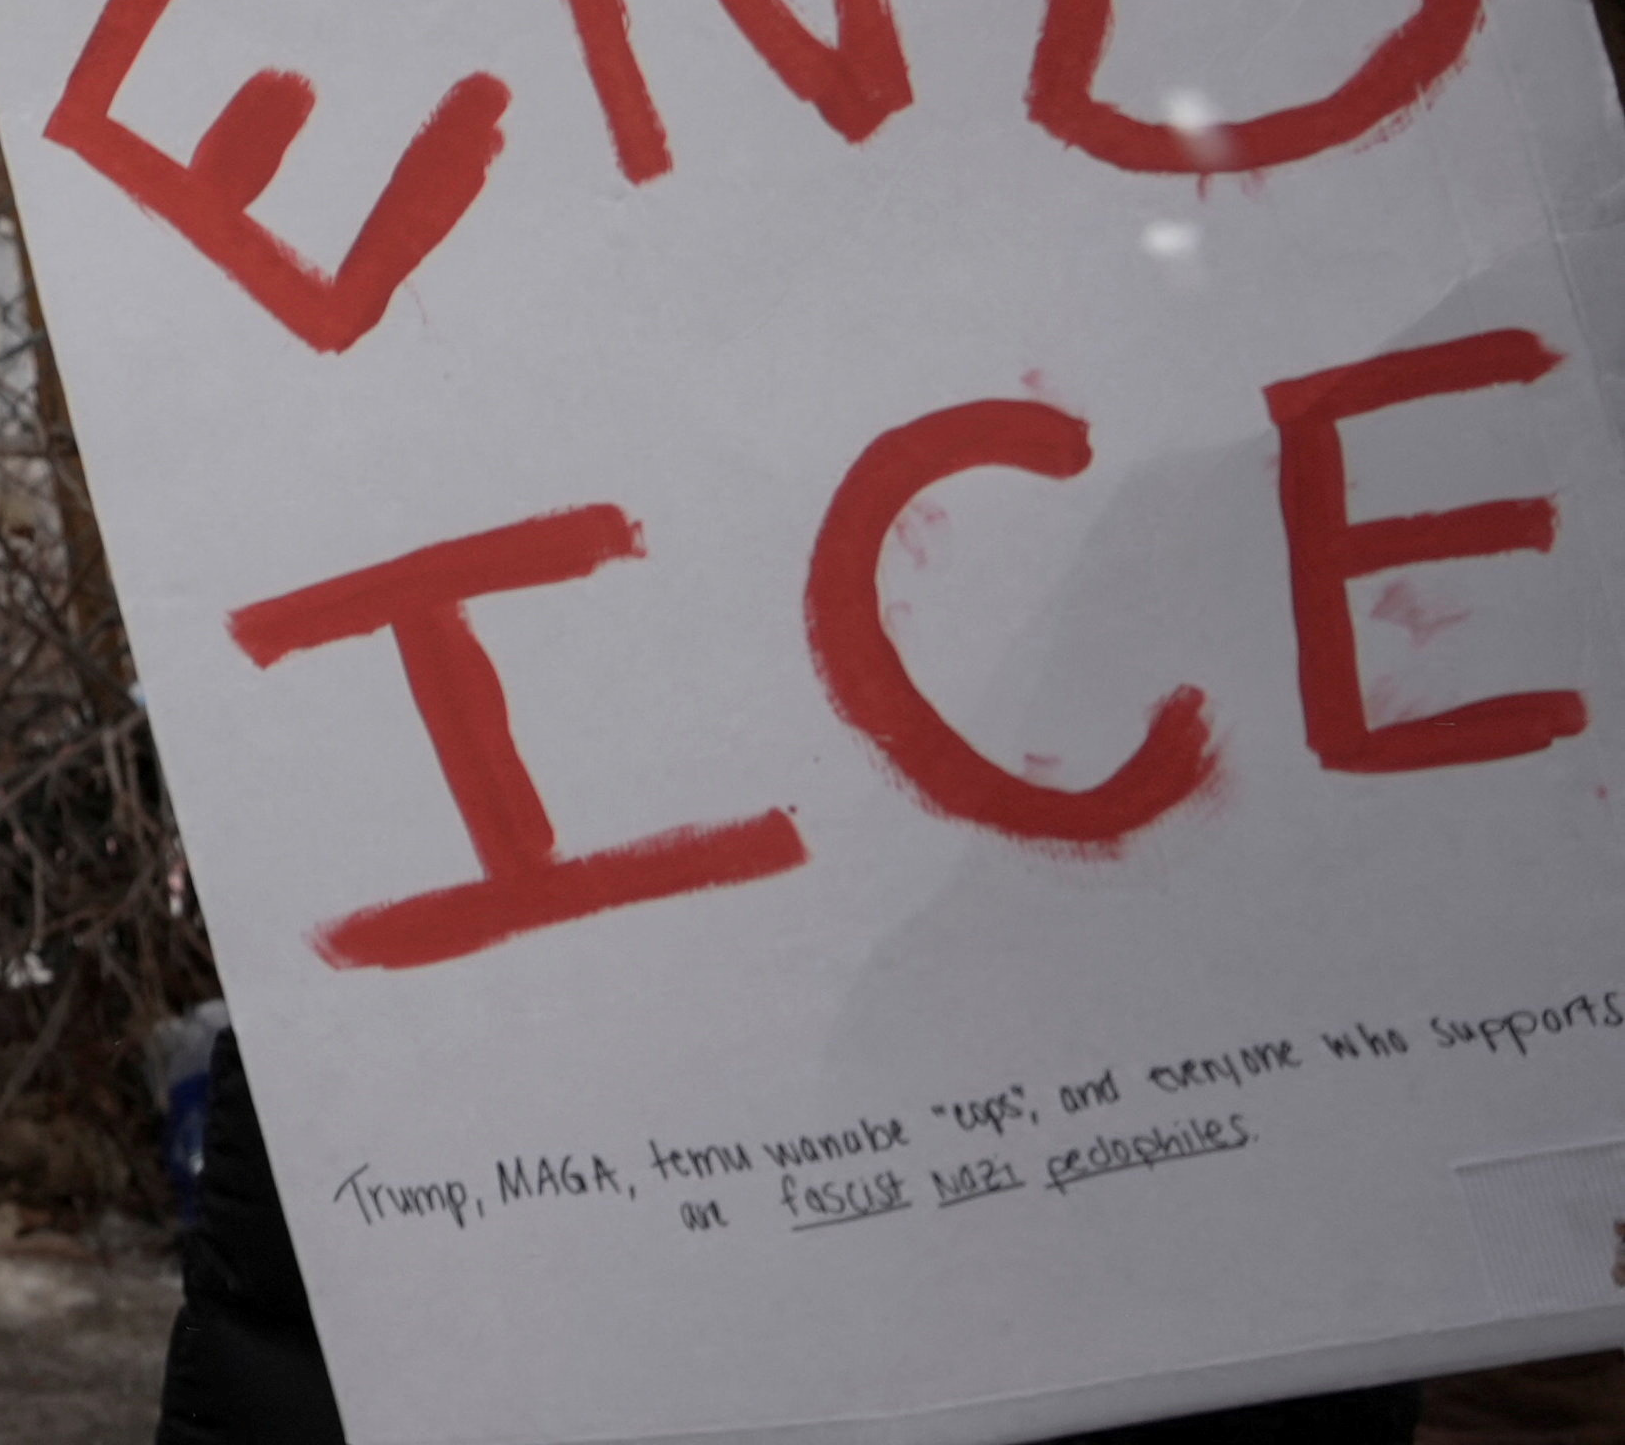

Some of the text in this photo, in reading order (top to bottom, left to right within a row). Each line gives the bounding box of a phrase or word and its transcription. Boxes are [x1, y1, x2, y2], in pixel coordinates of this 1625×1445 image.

[226, 327, 1587, 969] ICE
[333, 1163, 484, 1228] Trump,
[496, 1154, 636, 1201] MAGA,
[1060, 1069, 1120, 1113] and
[1147, 1037, 1303, 1093] everyone
[1321, 1022, 1409, 1061] who
[1430, 991, 1624, 1054] supports
[781, 1169, 908, 1219] fascist
